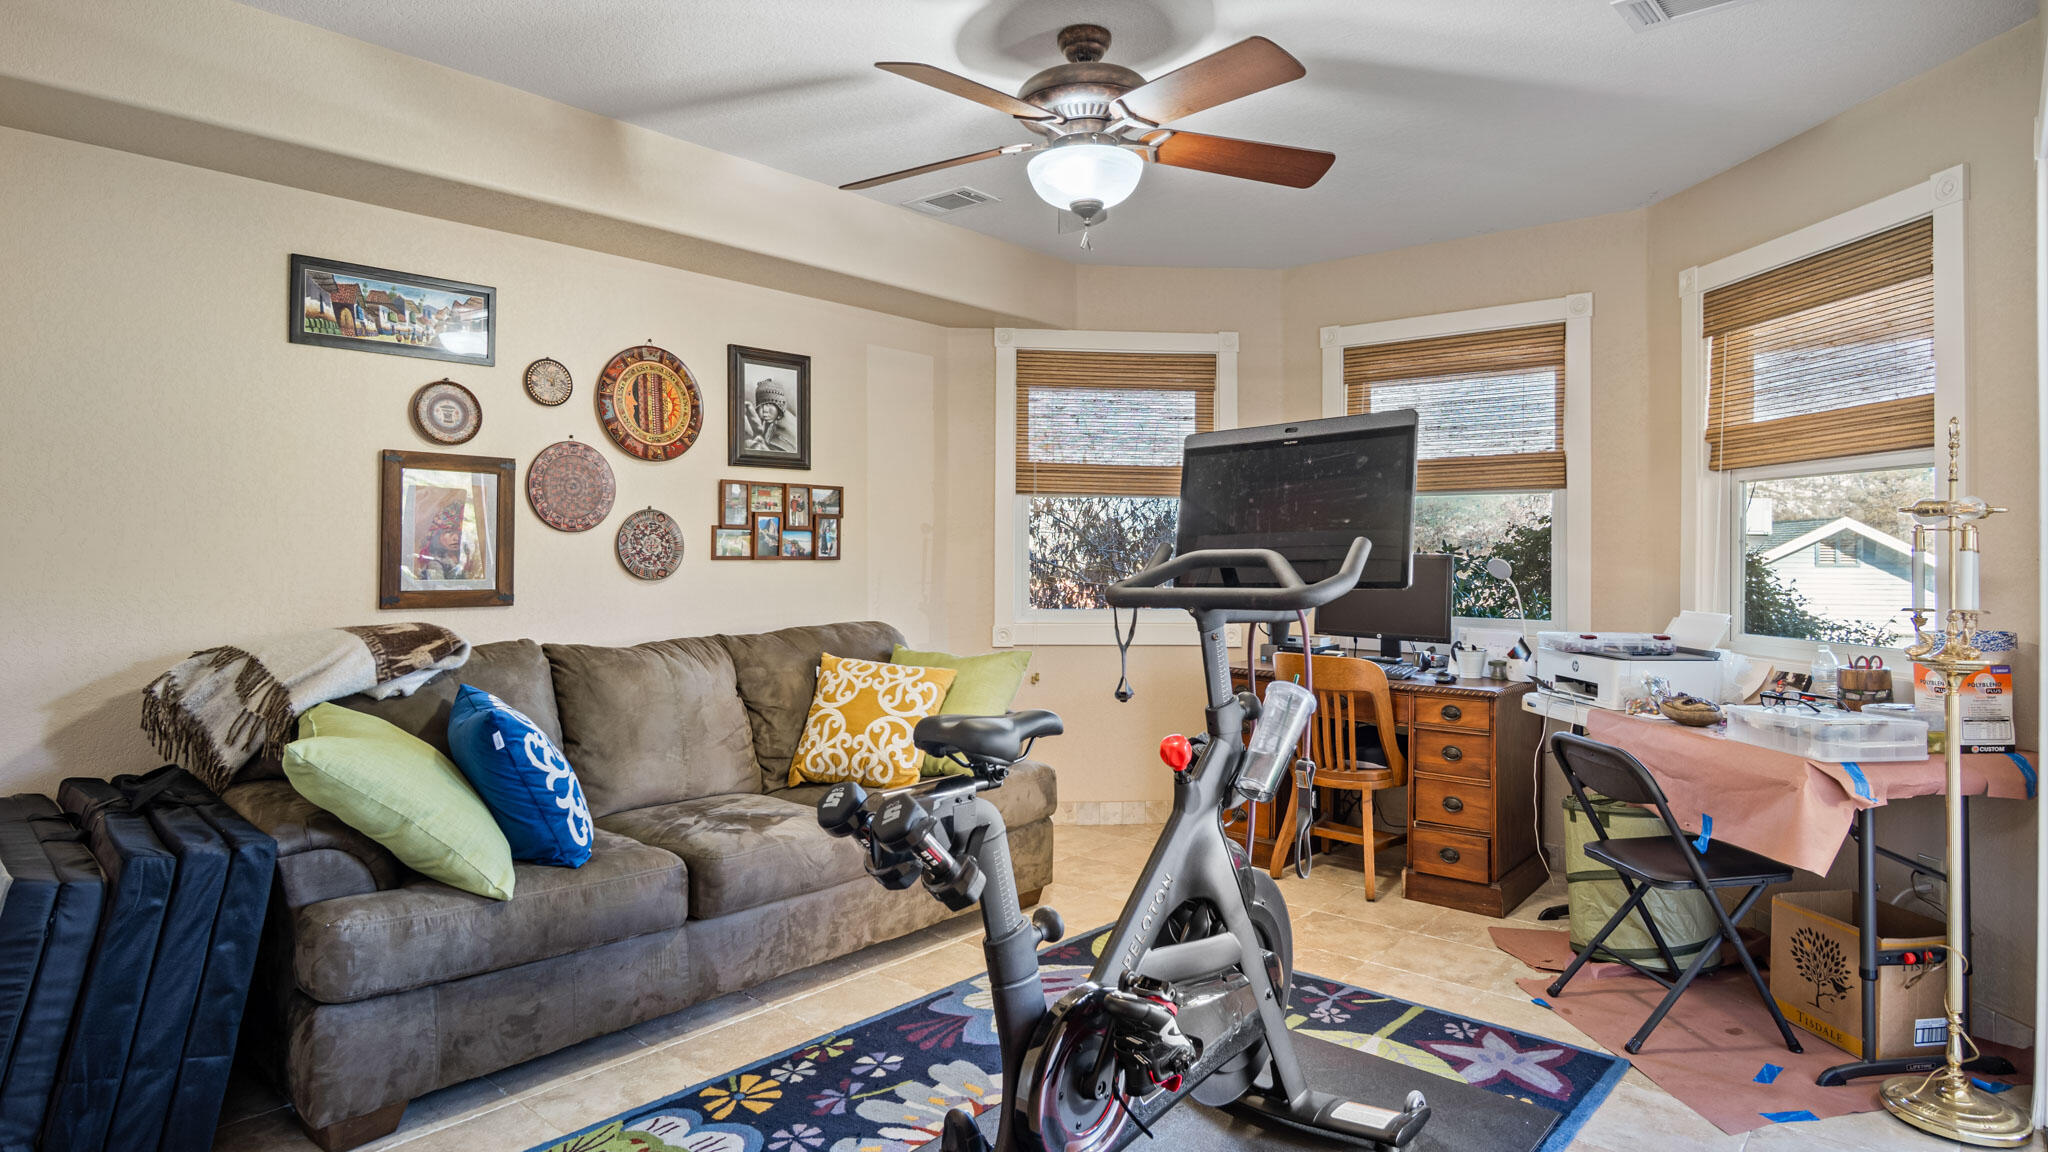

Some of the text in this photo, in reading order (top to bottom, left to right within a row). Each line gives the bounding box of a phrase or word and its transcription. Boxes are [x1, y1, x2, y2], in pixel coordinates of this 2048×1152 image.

[1920, 679, 1946, 687] POLYBLEN
[822, 792, 845, 809] 5
[1121, 872, 1174, 970] PELOTON
[1796, 1009, 1844, 1044] TISDALE
